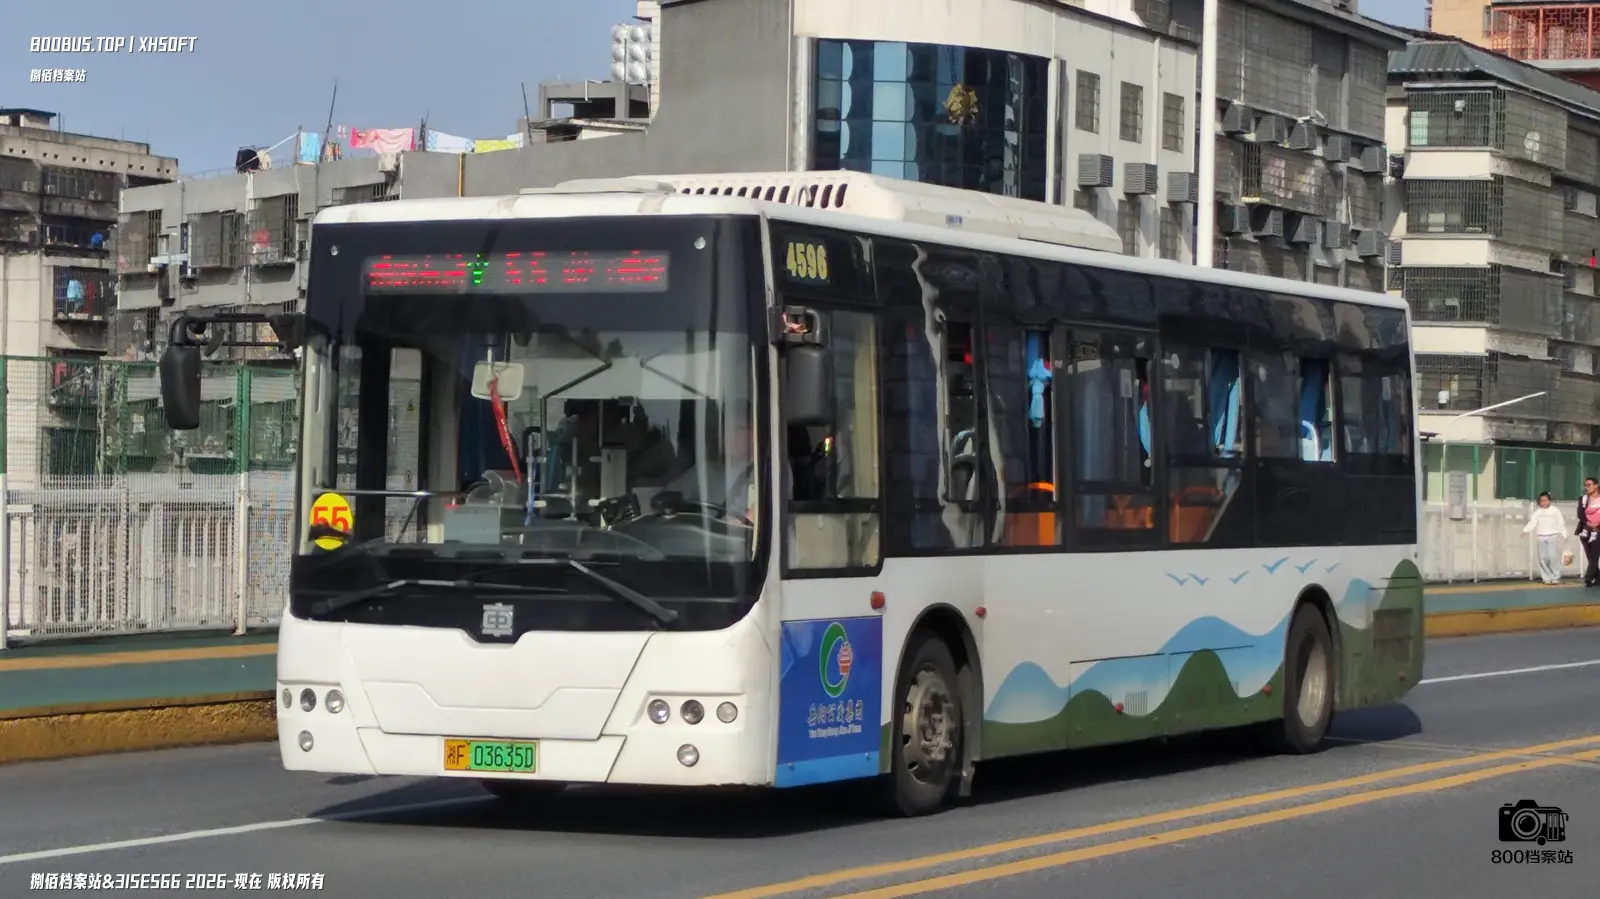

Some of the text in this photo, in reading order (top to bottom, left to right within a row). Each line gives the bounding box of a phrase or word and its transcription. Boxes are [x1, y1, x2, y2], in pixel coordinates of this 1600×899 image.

[787, 242, 828, 280] 4596
[313, 506, 349, 533] 55
[474, 745, 534, 768] 03635D
